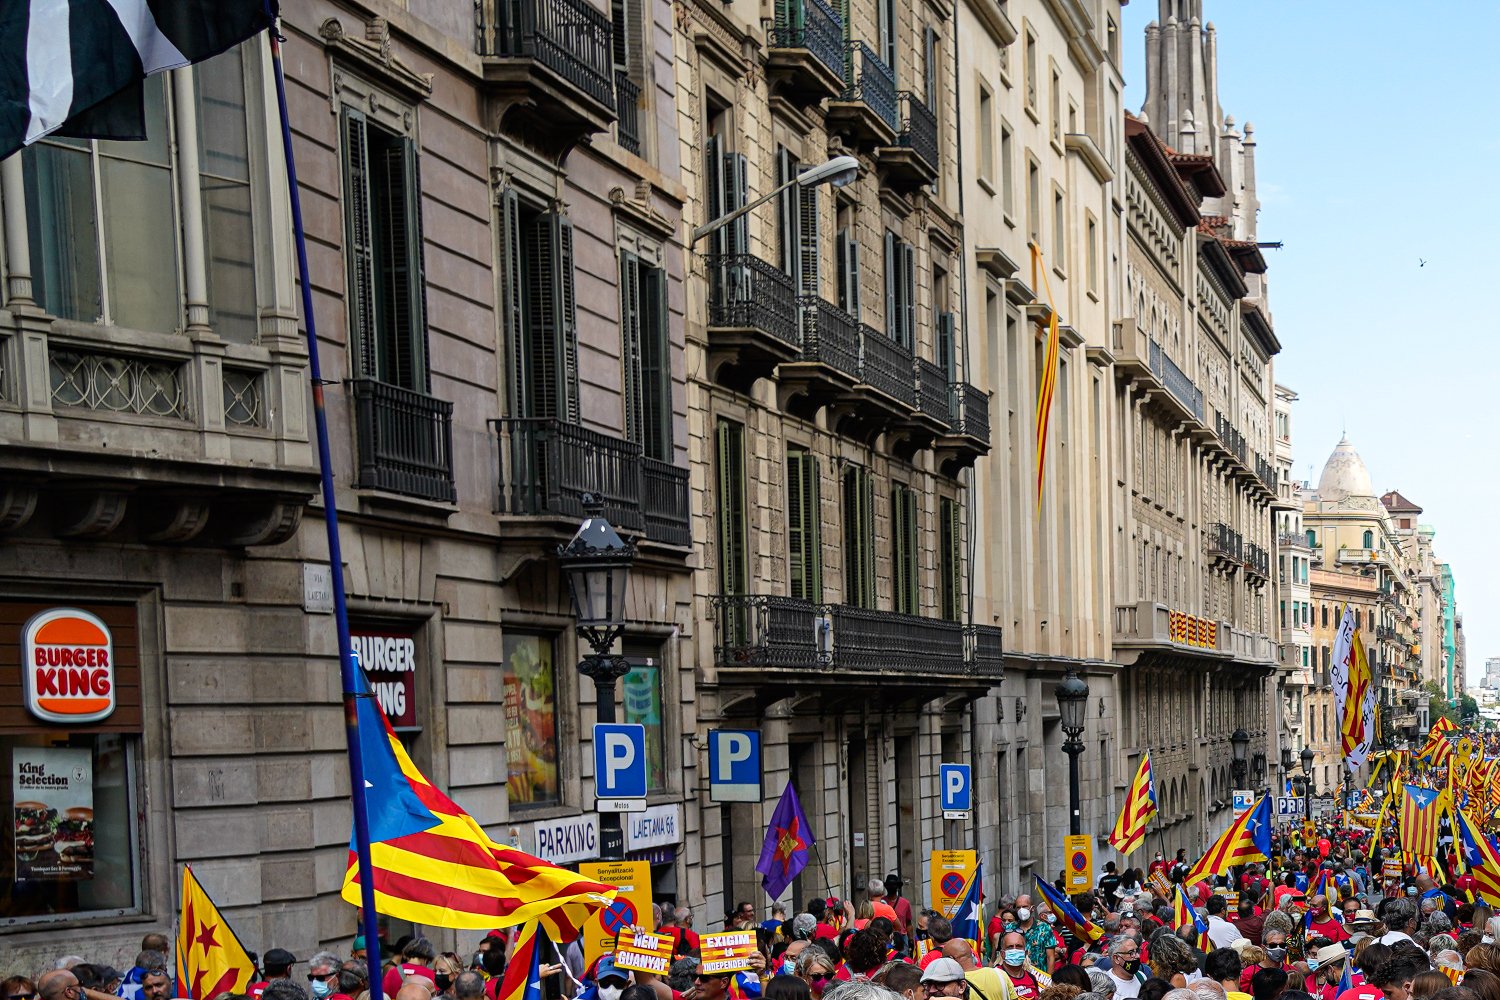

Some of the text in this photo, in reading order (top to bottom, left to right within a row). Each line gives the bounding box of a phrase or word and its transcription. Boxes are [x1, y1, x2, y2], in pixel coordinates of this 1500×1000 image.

[34, 647, 109, 668] BURGER
[36, 667, 111, 696] KING
[371, 682, 406, 716] ING
[605, 732, 635, 790] P
[718, 732, 752, 781] P
[19, 762, 45, 776] King
[19, 773, 69, 786] Selection
[946, 770, 965, 805] P
[614, 801, 629, 809] Motos
[633, 816, 675, 840] LAIETANA 66
[539, 821, 596, 859] PARKING
[597, 867, 634, 876] Senyalització
[633, 934, 659, 950] HEM
[706, 934, 750, 948] EXIGIM
[617, 951, 668, 971] GUANYAT
[724, 947, 735, 957] LA
